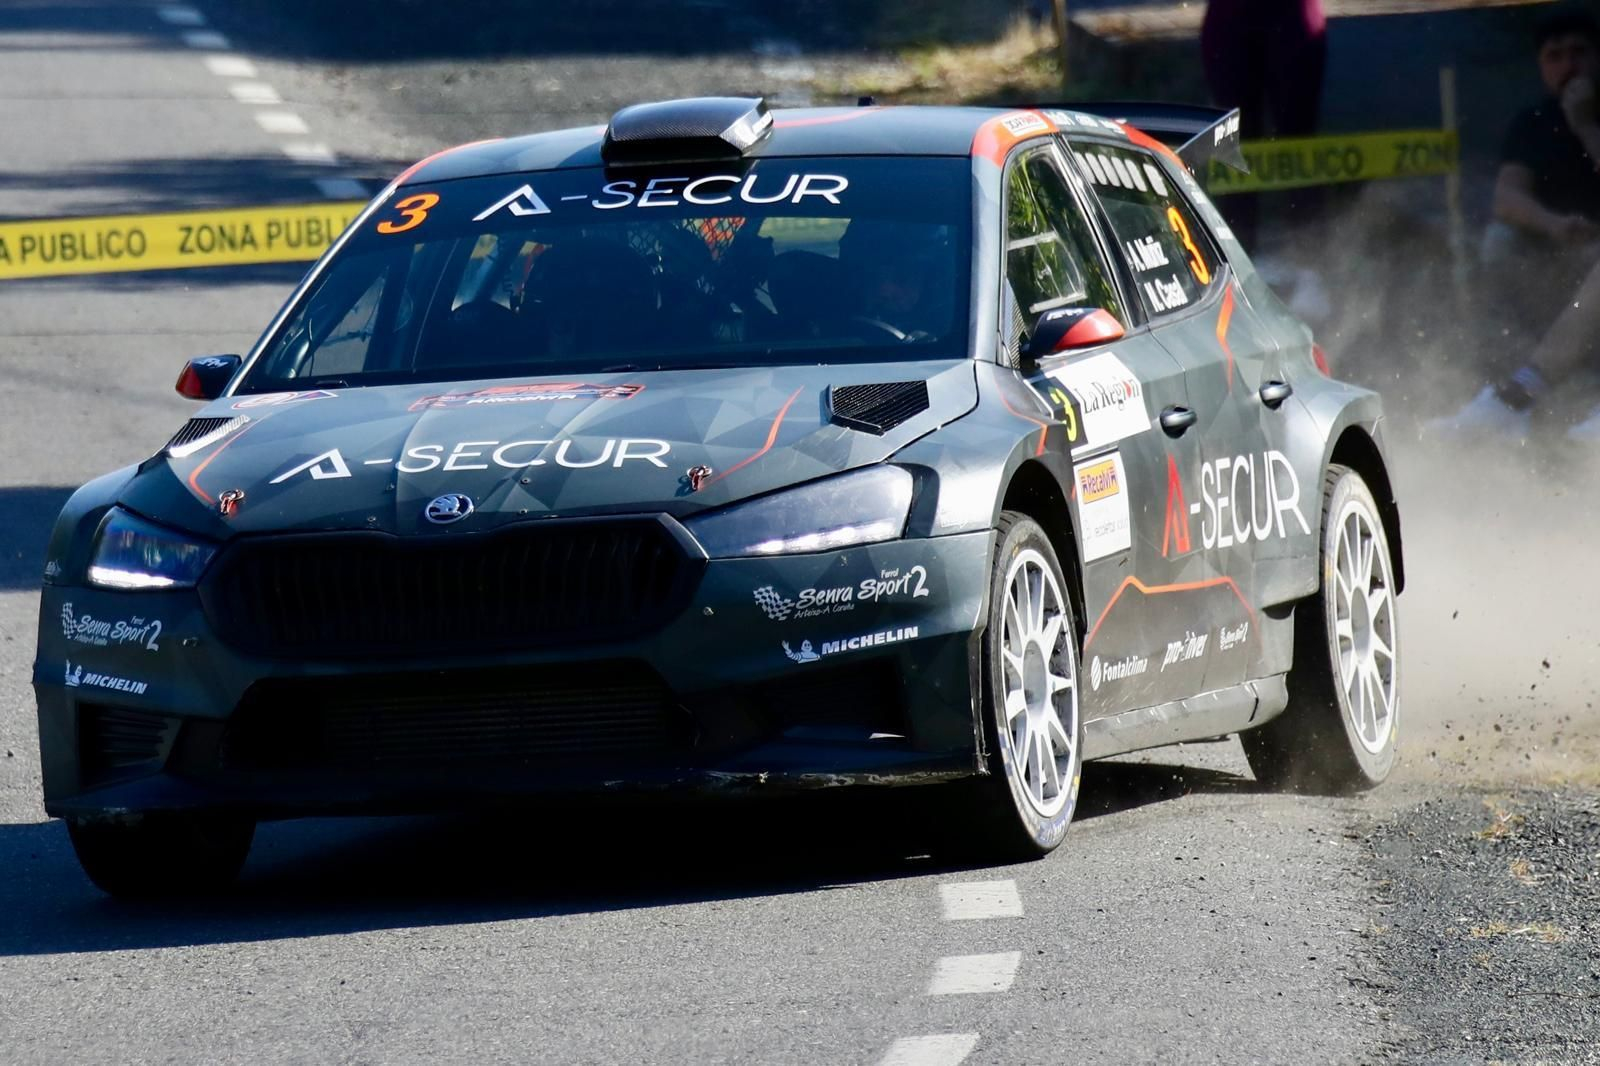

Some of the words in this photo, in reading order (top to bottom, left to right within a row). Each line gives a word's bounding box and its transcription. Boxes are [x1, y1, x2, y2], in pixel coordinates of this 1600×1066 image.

[377, 193, 440, 234] 3
[21, 229, 147, 264] PUBLICO
[179, 222, 256, 254] ZONA
[1167, 207, 1209, 285] 3
[796, 587, 853, 609] Senra
[857, 572, 911, 603] Sport
[910, 565, 929, 598] 2
[77, 615, 111, 636] Senra
[110, 621, 150, 645] Sport
[146, 620, 162, 651] 2
[821, 626, 919, 655] MICHELIN
[82, 672, 148, 694] MICHELIN
